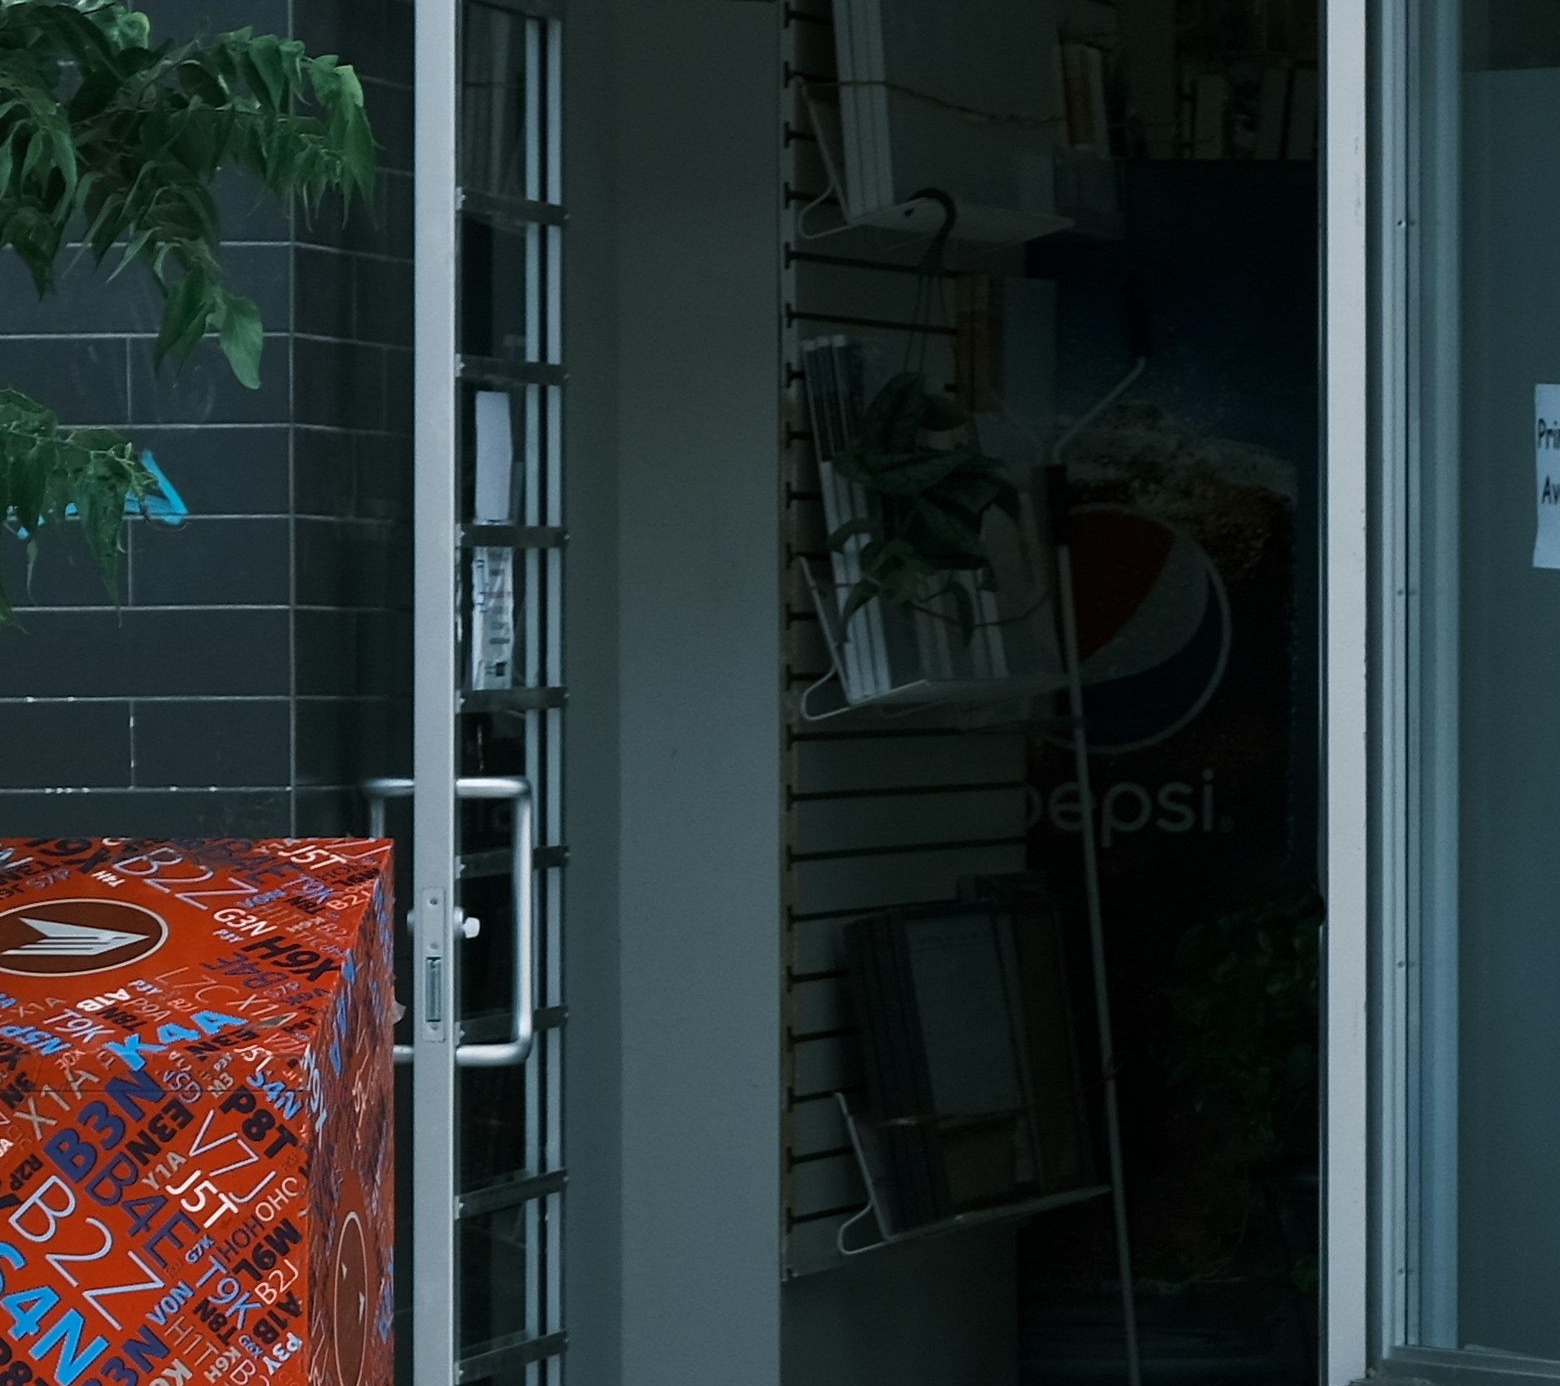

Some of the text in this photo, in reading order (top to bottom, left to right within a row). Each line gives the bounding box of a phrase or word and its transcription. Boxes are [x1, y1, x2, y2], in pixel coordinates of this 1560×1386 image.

[213, 908, 278, 937] G3N
[105, 1009, 248, 1071] K4A
[42, 1067, 167, 1183] B3N
[188, 1109, 276, 1203] V7J
[219, 1084, 298, 1158] P8T
[84, 1150, 201, 1267] B4E
[165, 1169, 239, 1229] J5T
[7, 1174, 166, 1331] B2Z
